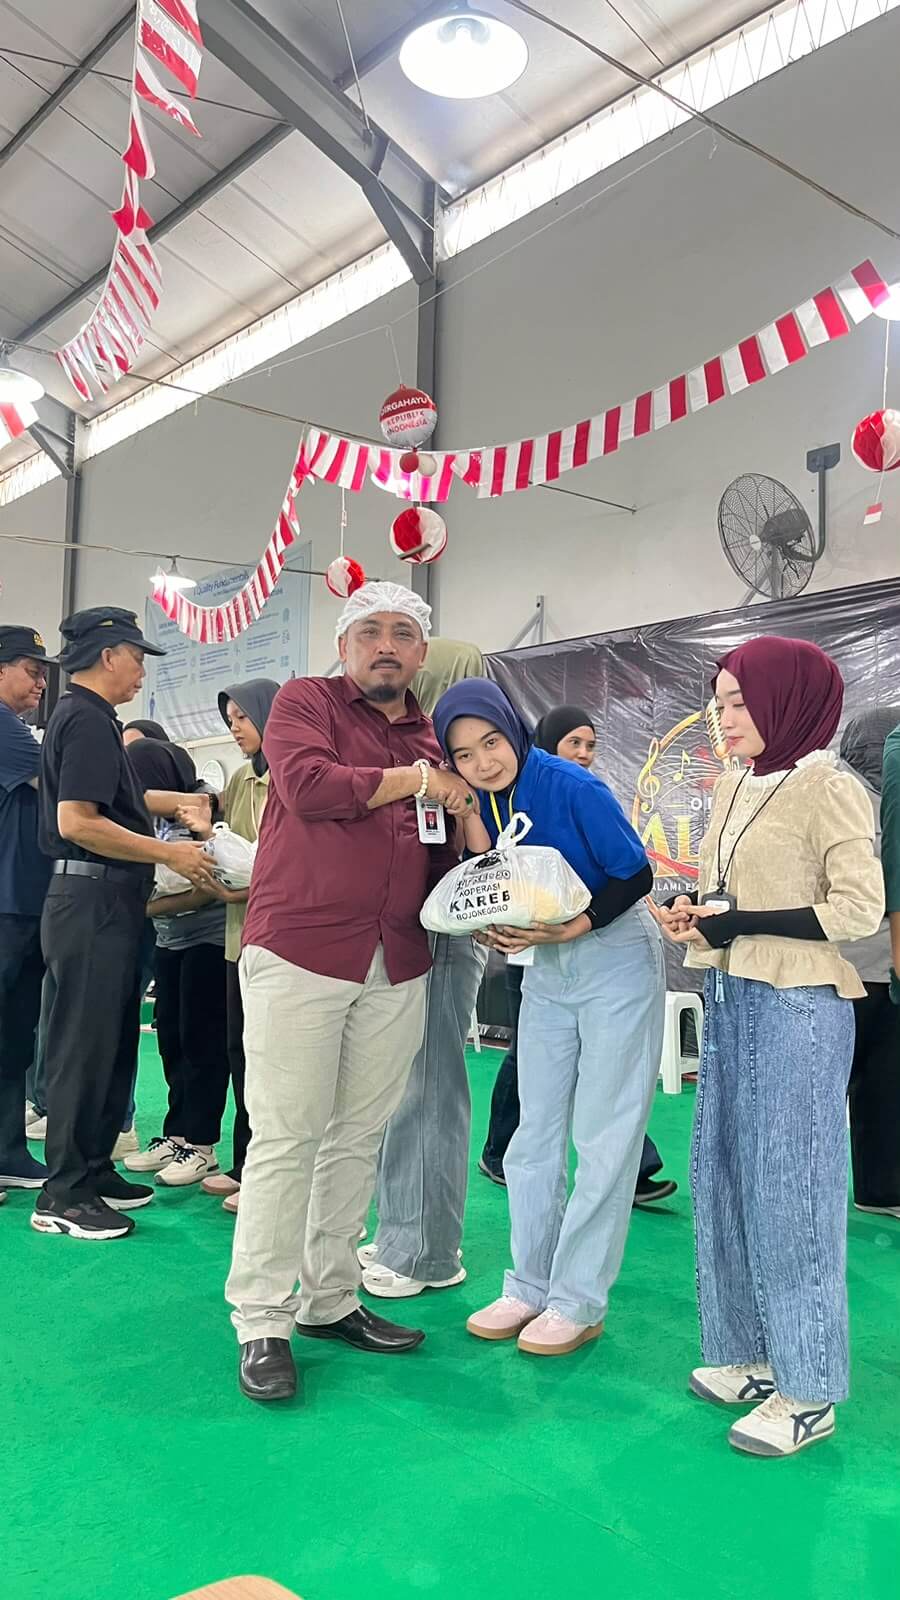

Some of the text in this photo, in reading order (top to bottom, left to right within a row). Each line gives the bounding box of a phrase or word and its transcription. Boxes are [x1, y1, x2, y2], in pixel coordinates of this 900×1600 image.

[386, 418, 428, 435] INDONESIA
[449, 890, 511, 913] KAREB
[456, 904, 509, 921] BOJONEGORO
